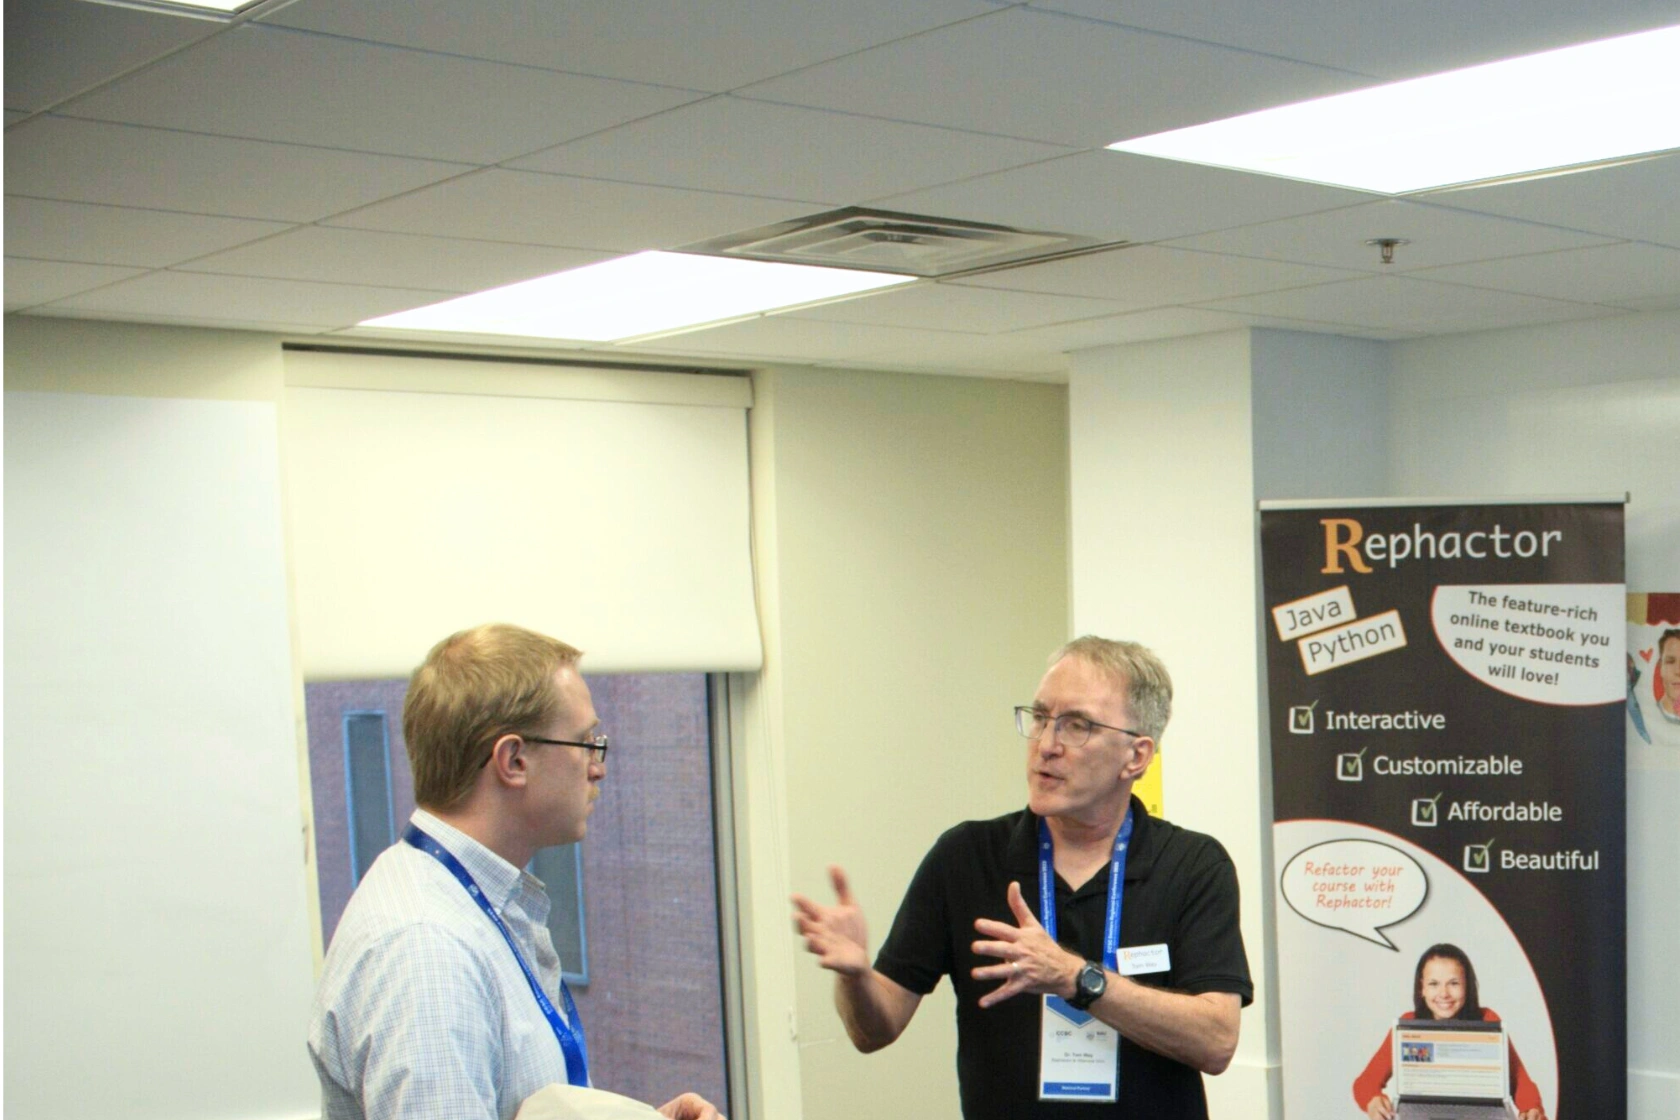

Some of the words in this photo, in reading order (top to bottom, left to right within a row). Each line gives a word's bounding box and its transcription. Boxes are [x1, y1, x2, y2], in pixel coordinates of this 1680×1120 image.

[1319, 517, 1562, 574] Rephactor
[1286, 598, 1341, 631] Java
[1468, 591, 1498, 607] The
[1501, 594, 1599, 622] feature-rich
[1449, 611, 1501, 631] online
[1503, 618, 1575, 642] textbook
[1579, 631, 1611, 648] you
[1308, 621, 1396, 662] Python
[1453, 634, 1484, 652] and
[1488, 641, 1526, 661] your
[1528, 648, 1602, 669] students
[1487, 664, 1515, 681] will
[1520, 670, 1560, 686] love!
[1325, 709, 1447, 732] Interactive
[1372, 755, 1524, 777] Customizable
[1447, 801, 1564, 822] Affordable
[1304, 860, 1366, 878] Refactor
[1371, 865, 1405, 880] your
[1500, 850, 1600, 872] Beautiful
[1311, 880, 1359, 894] course
[1364, 879, 1396, 894] with
[1315, 894, 1393, 911] Rephactor!
